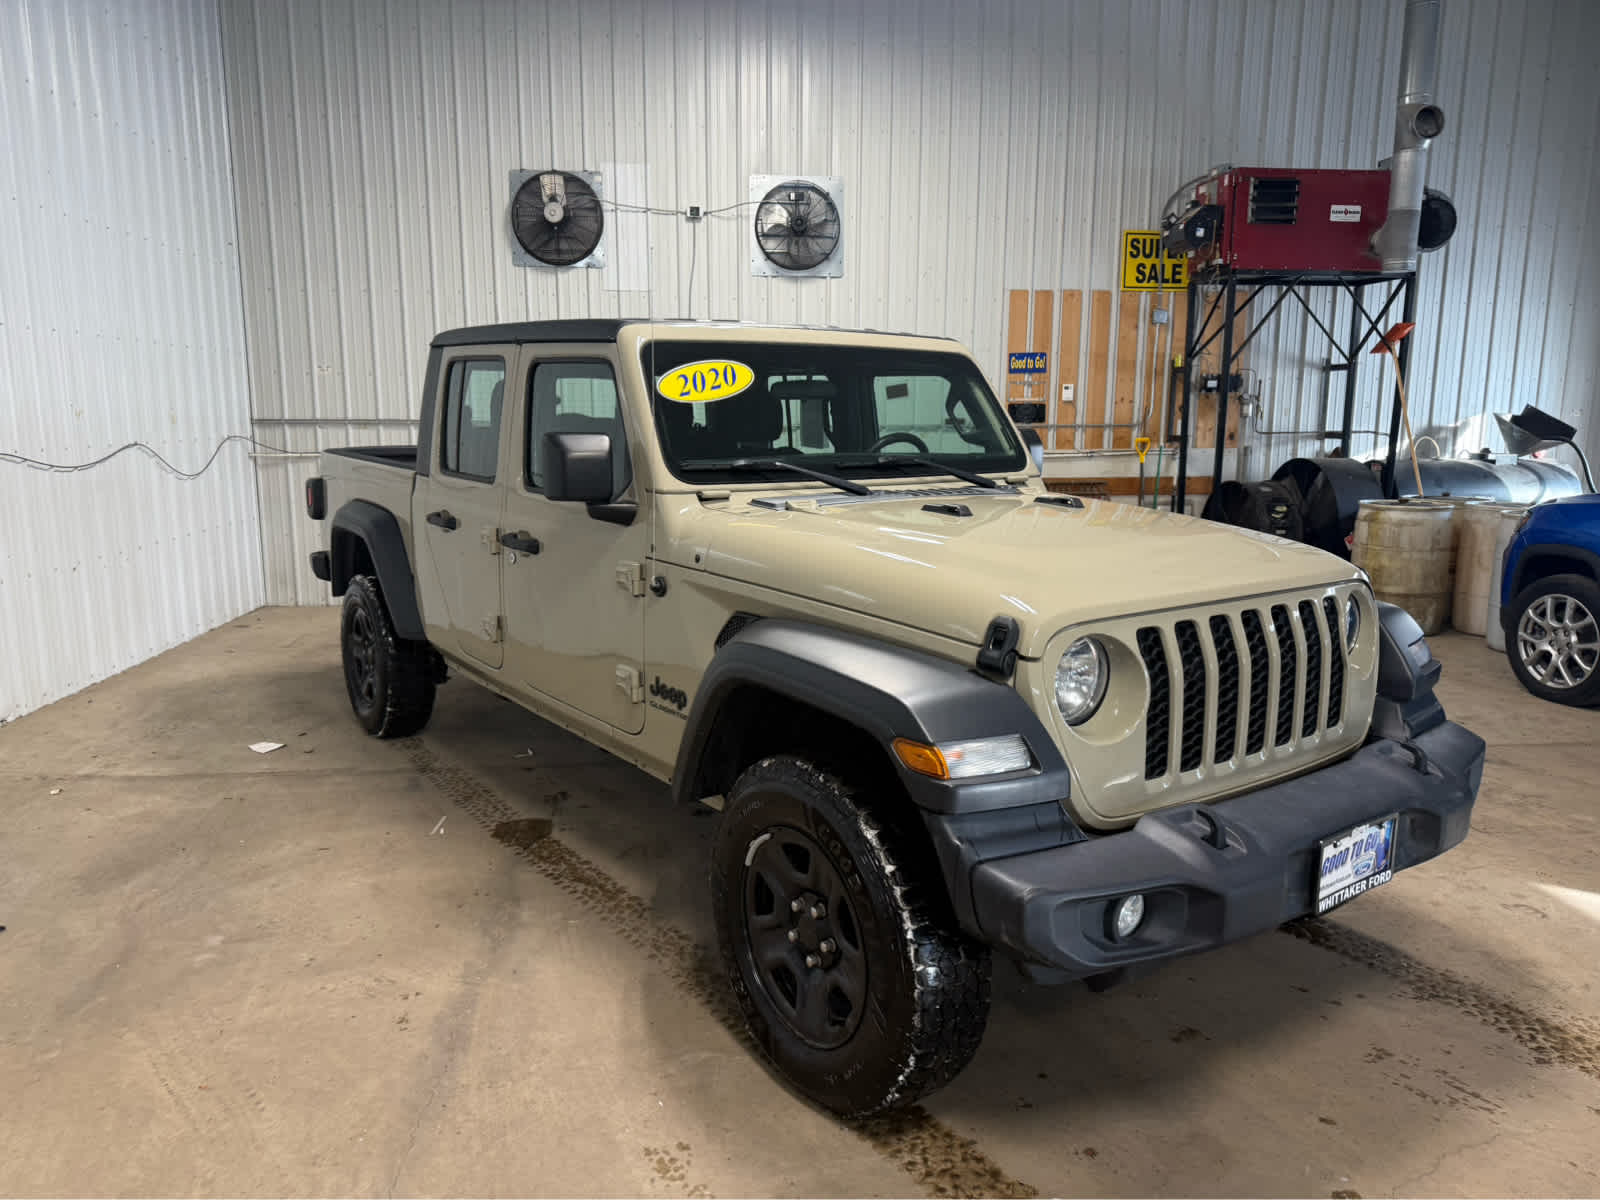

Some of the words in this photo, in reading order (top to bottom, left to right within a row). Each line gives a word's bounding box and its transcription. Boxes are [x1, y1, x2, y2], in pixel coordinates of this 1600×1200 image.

[1135, 262, 1183, 284] SALE
[1011, 356, 1026, 369] Good
[1027, 356, 1034, 369] to
[677, 364, 736, 397] 2020
[650, 676, 687, 710] Jeep
[1322, 847, 1350, 877] GOOD
[1351, 839, 1363, 860] TO
[1364, 831, 1378, 853] GO
[1319, 880, 1367, 913] WHITTAKER
[1368, 870, 1392, 889] FORD
